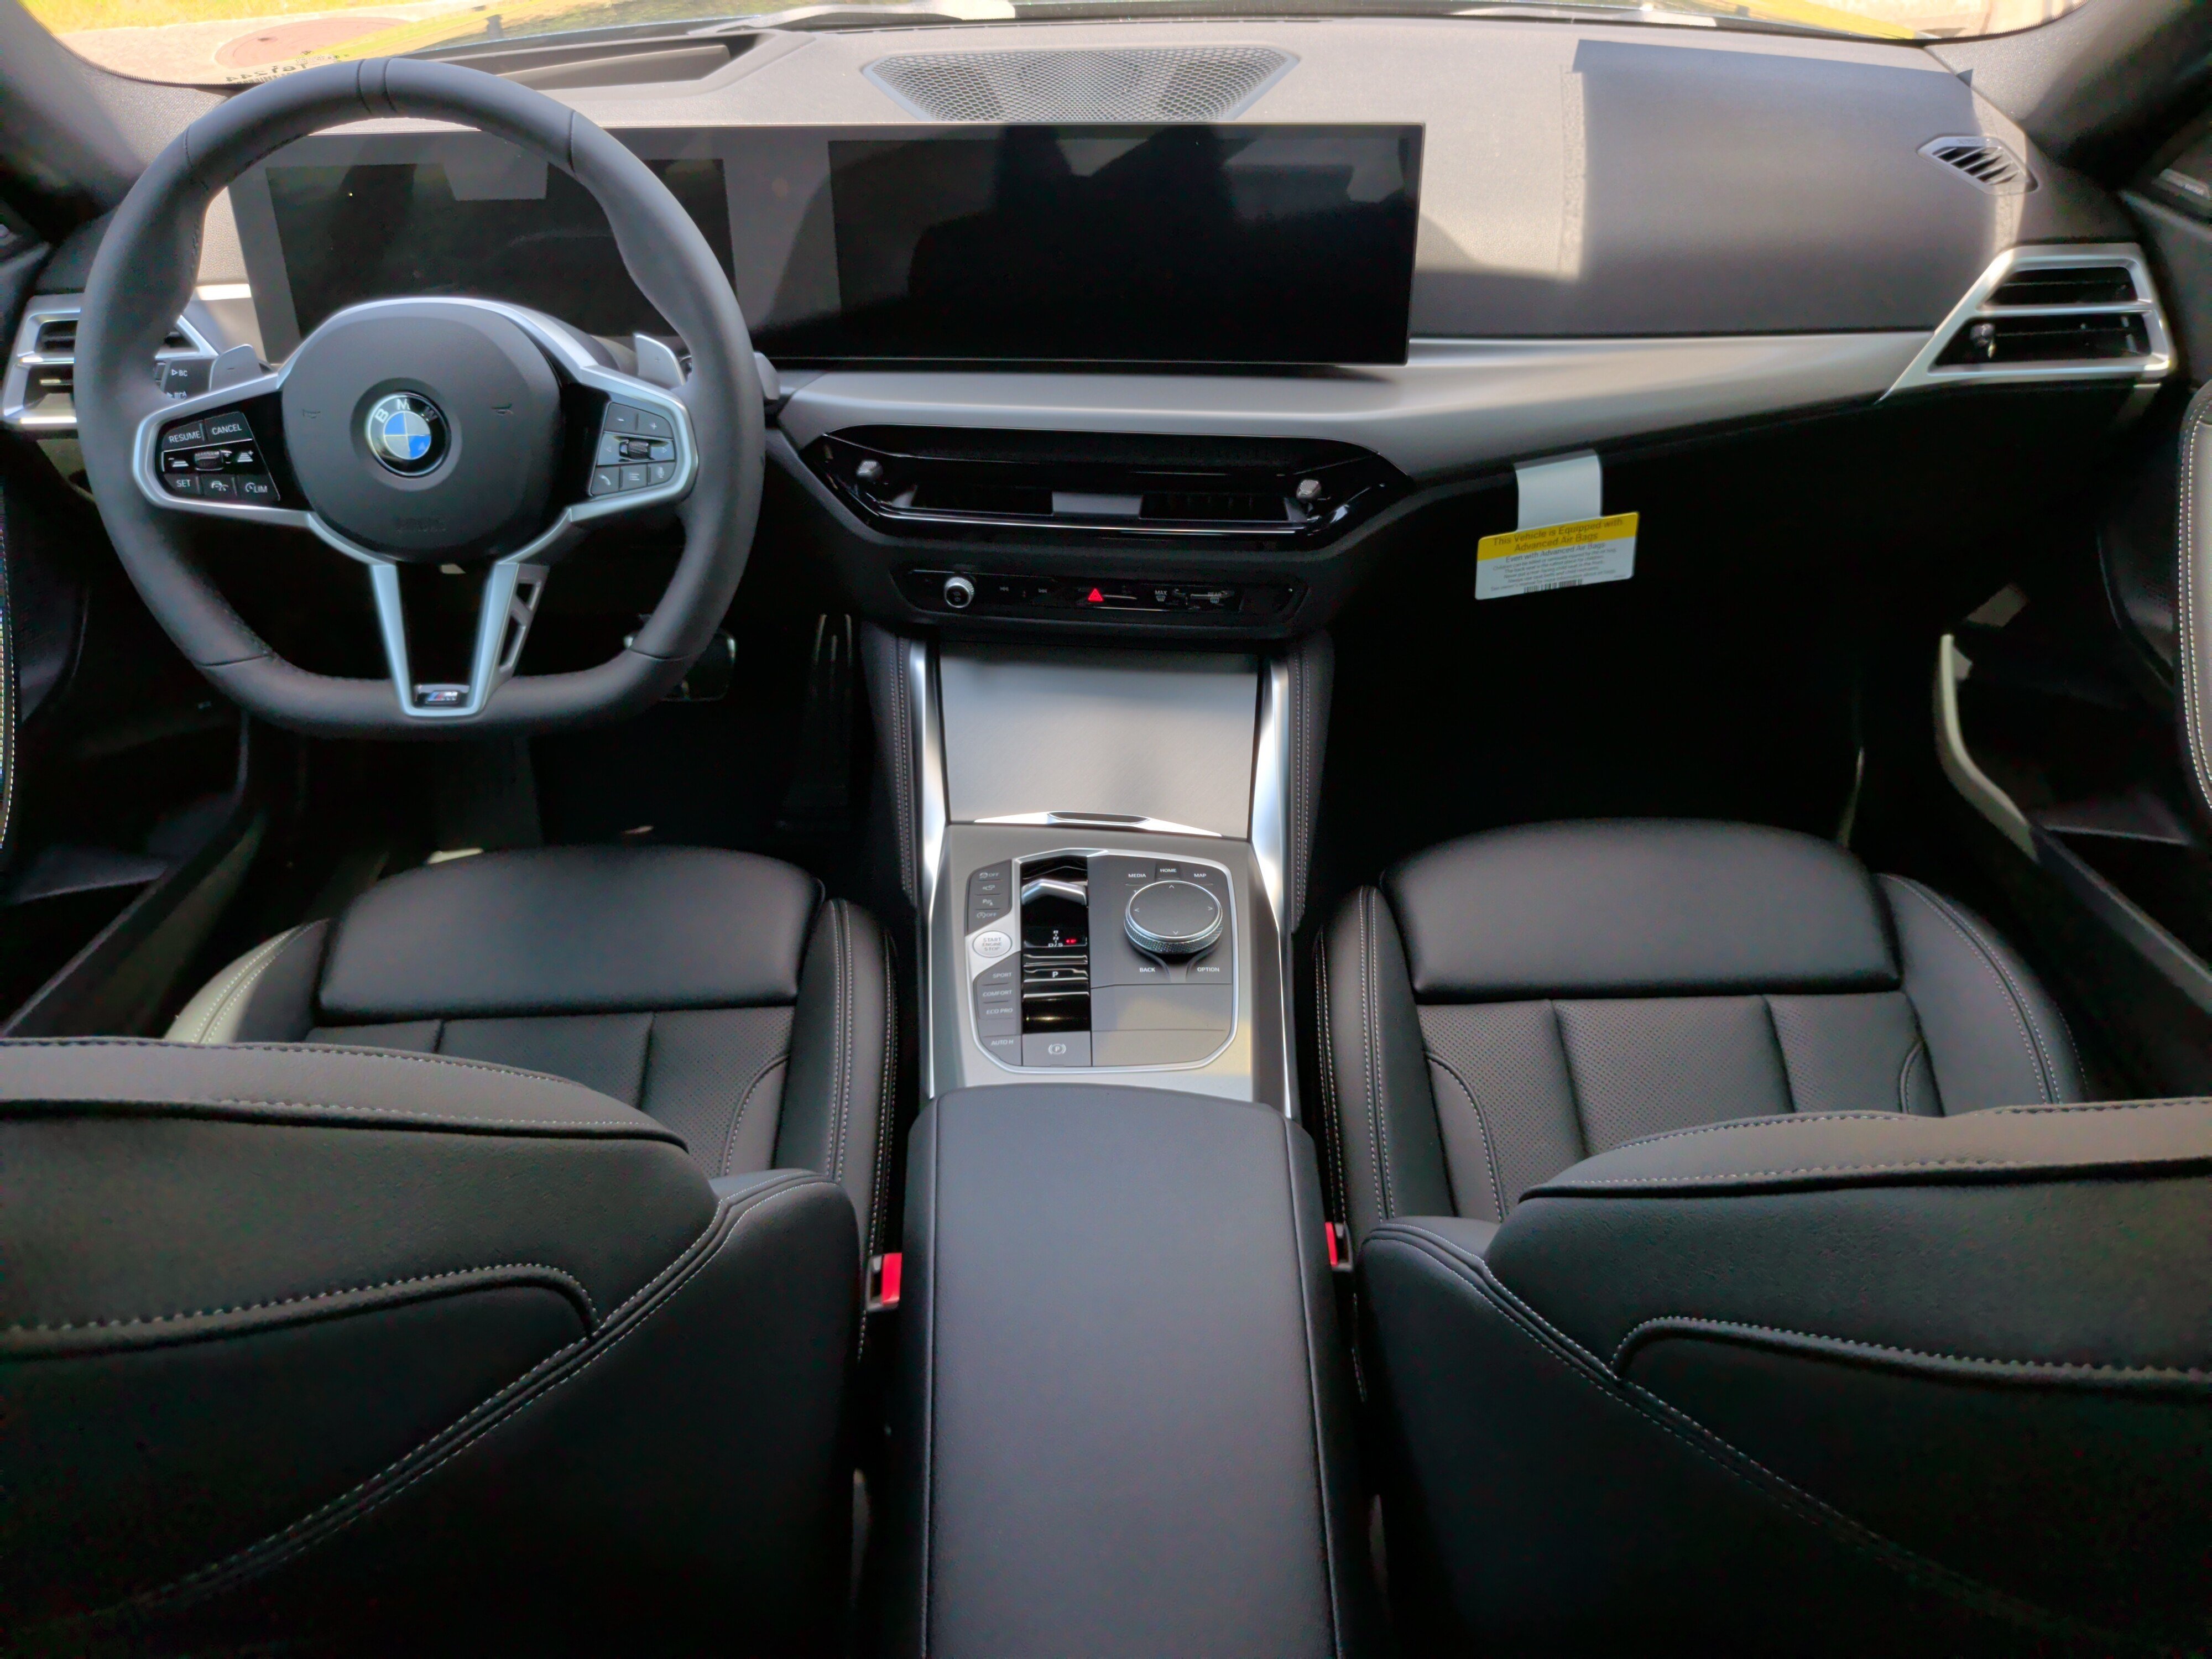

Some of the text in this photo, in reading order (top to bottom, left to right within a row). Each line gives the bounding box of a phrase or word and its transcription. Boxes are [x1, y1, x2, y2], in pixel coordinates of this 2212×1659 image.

[373, 398, 439, 424] BMW
[168, 430, 202, 444] RESUME
[212, 423, 242, 436] CANCEL
[176, 479, 191, 488] SET
[253, 485, 268, 493] LIM
[1493, 517, 1623, 546] This Vehicle is Equipped with
[1514, 530, 1598, 552] Advanced Air Bags
[1505, 554, 1522, 563] Even
[1524, 551, 1538, 560] with
[1540, 545, 1574, 557] Advanced
[1587, 540, 1605, 550] Bags
